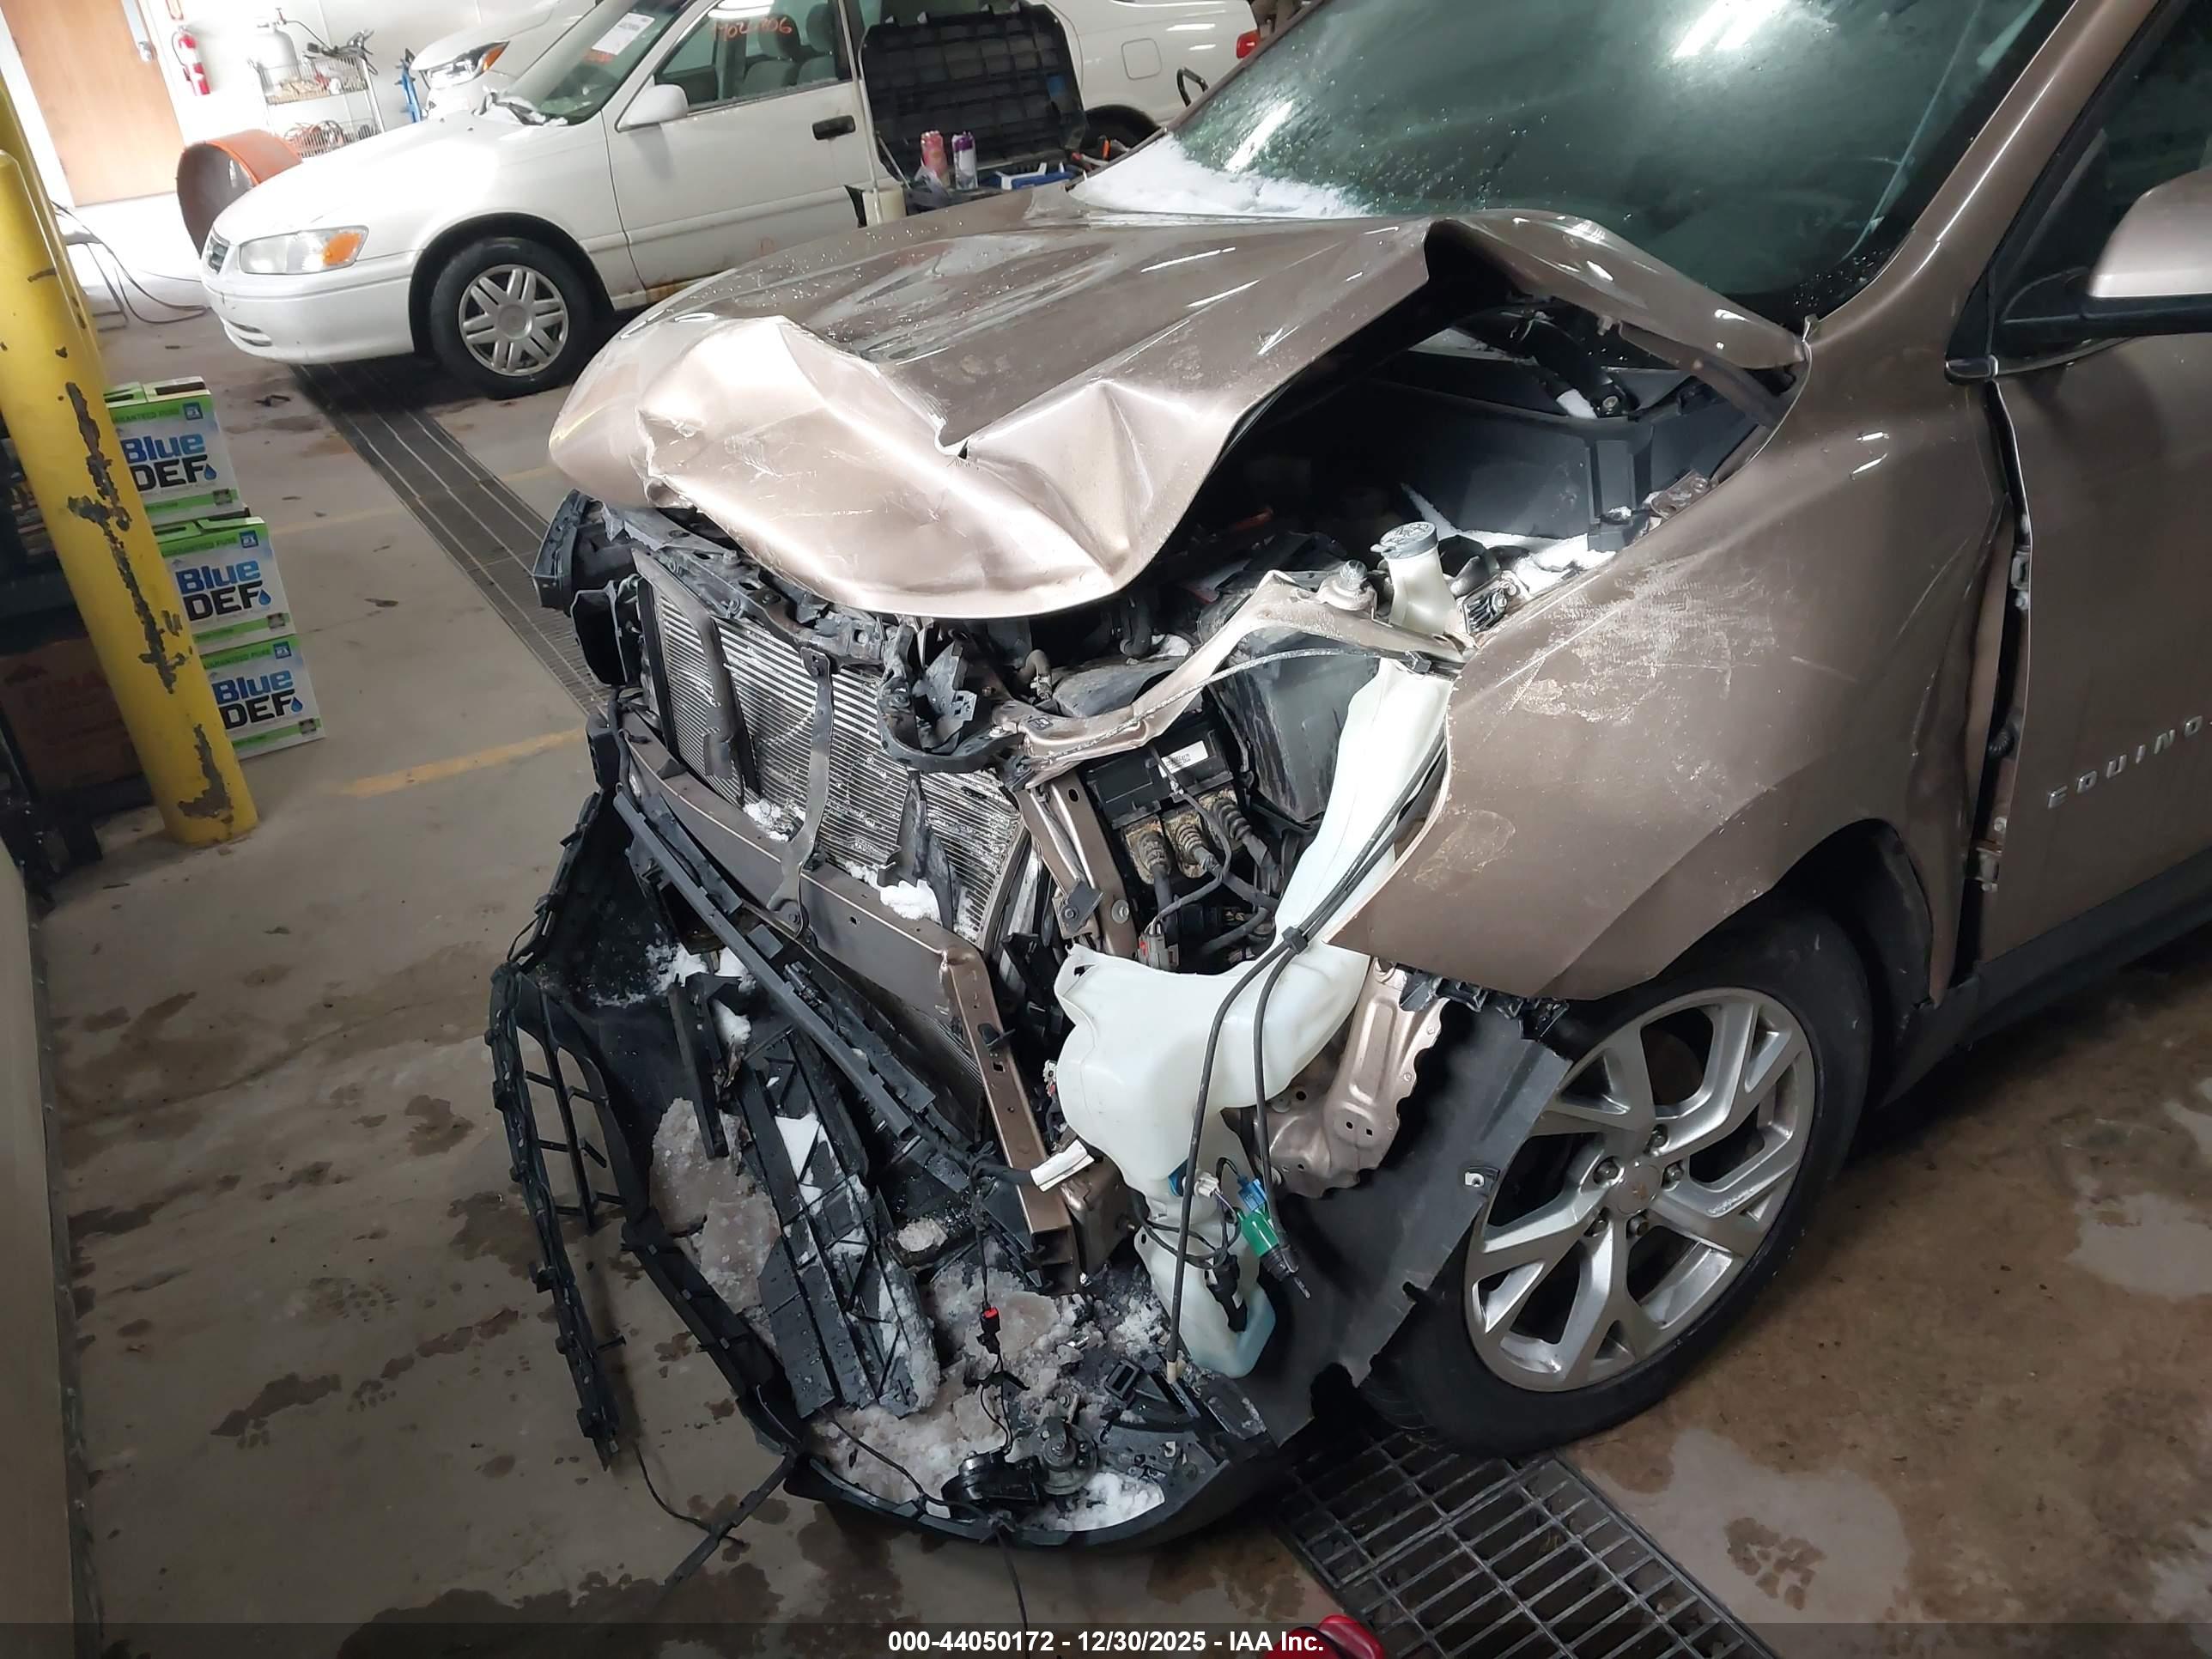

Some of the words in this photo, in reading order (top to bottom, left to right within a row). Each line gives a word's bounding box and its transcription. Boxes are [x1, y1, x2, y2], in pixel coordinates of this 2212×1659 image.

[120, 434, 205, 463] Blue
[129, 454, 208, 492] DEF
[175, 560, 260, 595] Blue
[183, 580, 263, 621] DEF
[211, 671, 294, 705] Blue
[218, 689, 295, 730] DEF
[2048, 715, 2212, 809] EQUINO
